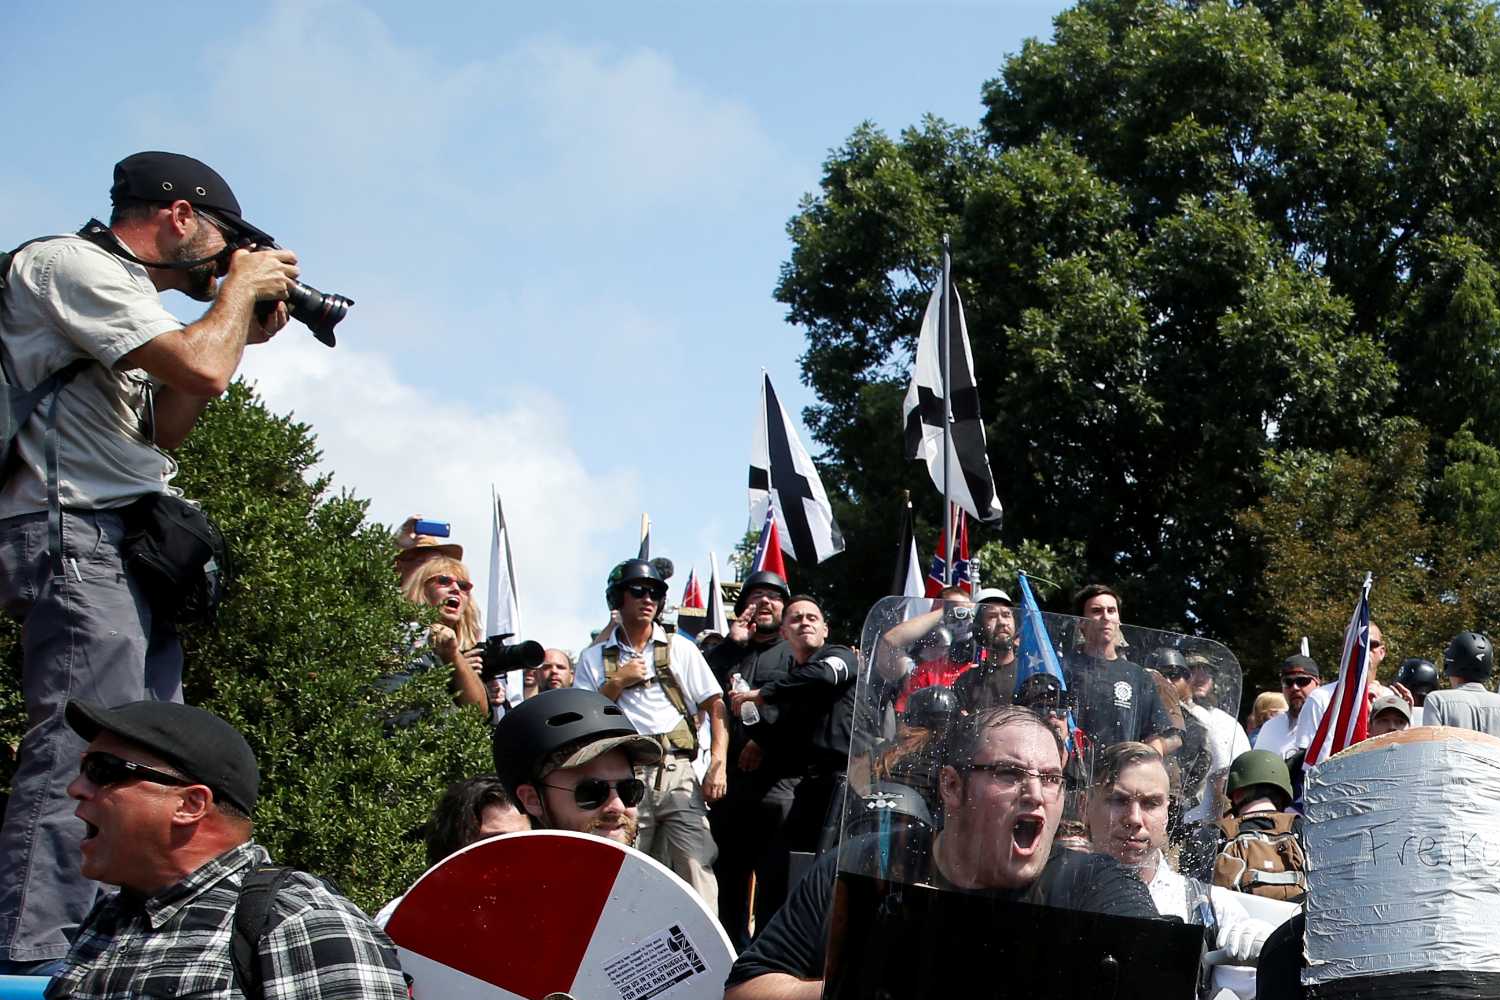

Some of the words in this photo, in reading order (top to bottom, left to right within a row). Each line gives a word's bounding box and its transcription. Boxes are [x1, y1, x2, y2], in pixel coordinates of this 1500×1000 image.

[635, 981, 653, 995] RACE
[652, 974, 667, 985] AND
[666, 961, 690, 977] NATION
